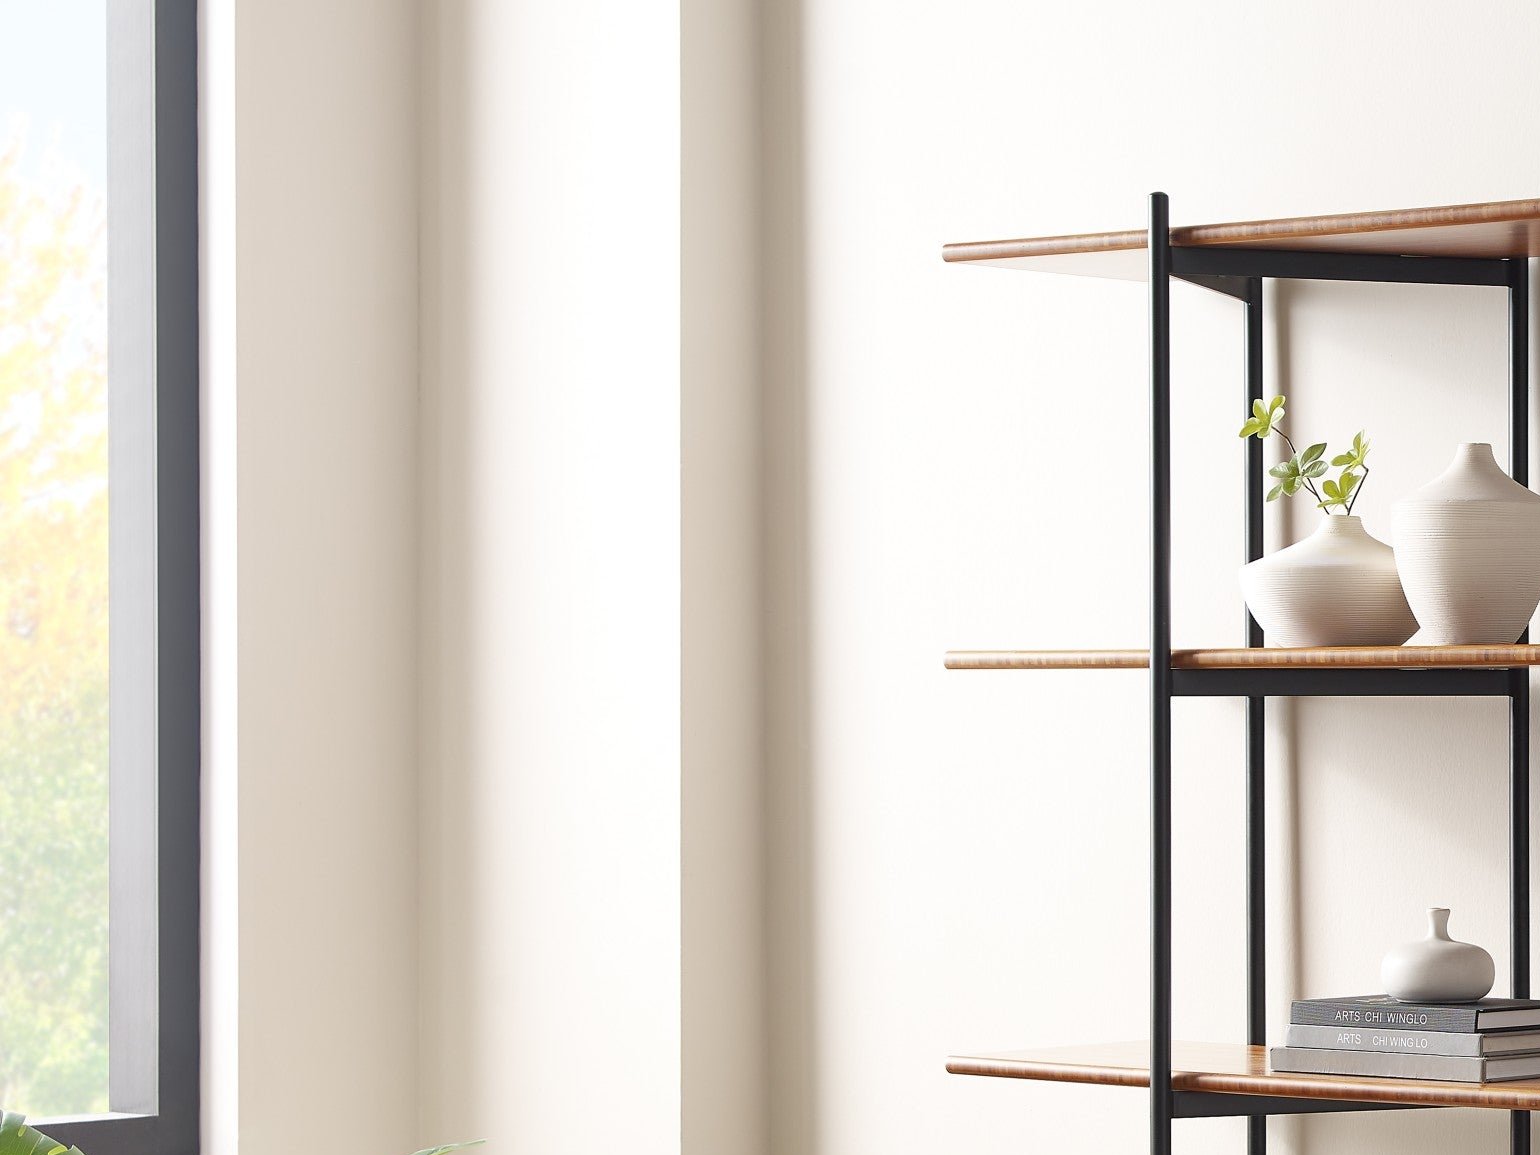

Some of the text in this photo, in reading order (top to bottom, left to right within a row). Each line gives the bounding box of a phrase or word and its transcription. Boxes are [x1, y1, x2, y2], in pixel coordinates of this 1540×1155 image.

[1335, 1010, 1360, 1021] ARTS
[1364, 1011, 1382, 1022] CHI
[1337, 1033, 1361, 1045] ARTS
[1372, 1036, 1388, 1046] CHI
